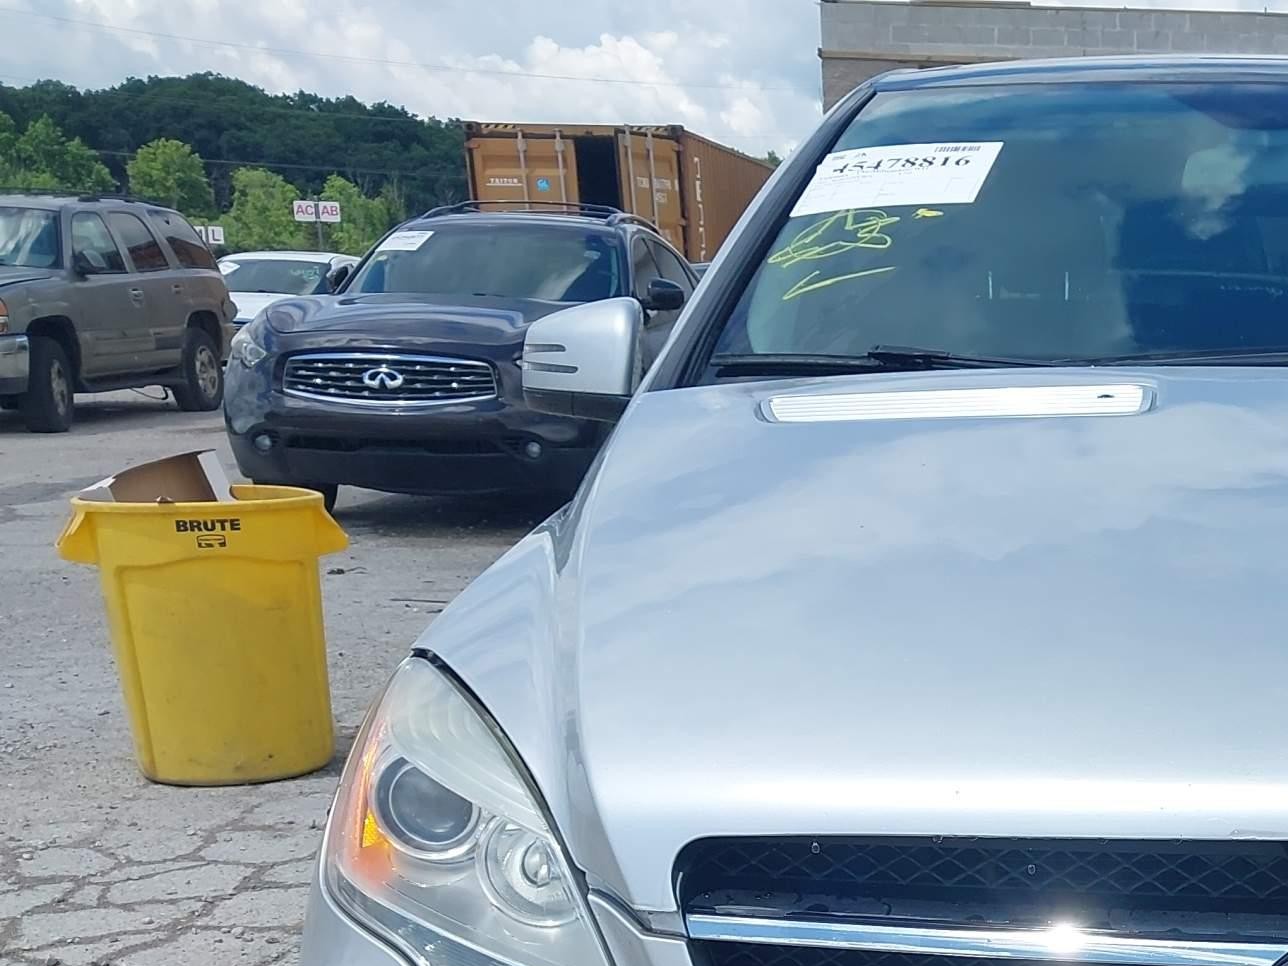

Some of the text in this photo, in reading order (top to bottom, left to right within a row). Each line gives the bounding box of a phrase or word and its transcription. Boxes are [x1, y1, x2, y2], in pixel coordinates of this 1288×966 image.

[296, 204, 315, 216] AC
[321, 205, 339, 217] AB
[211, 229, 221, 241] L
[174, 518, 241, 532] BRUTE
